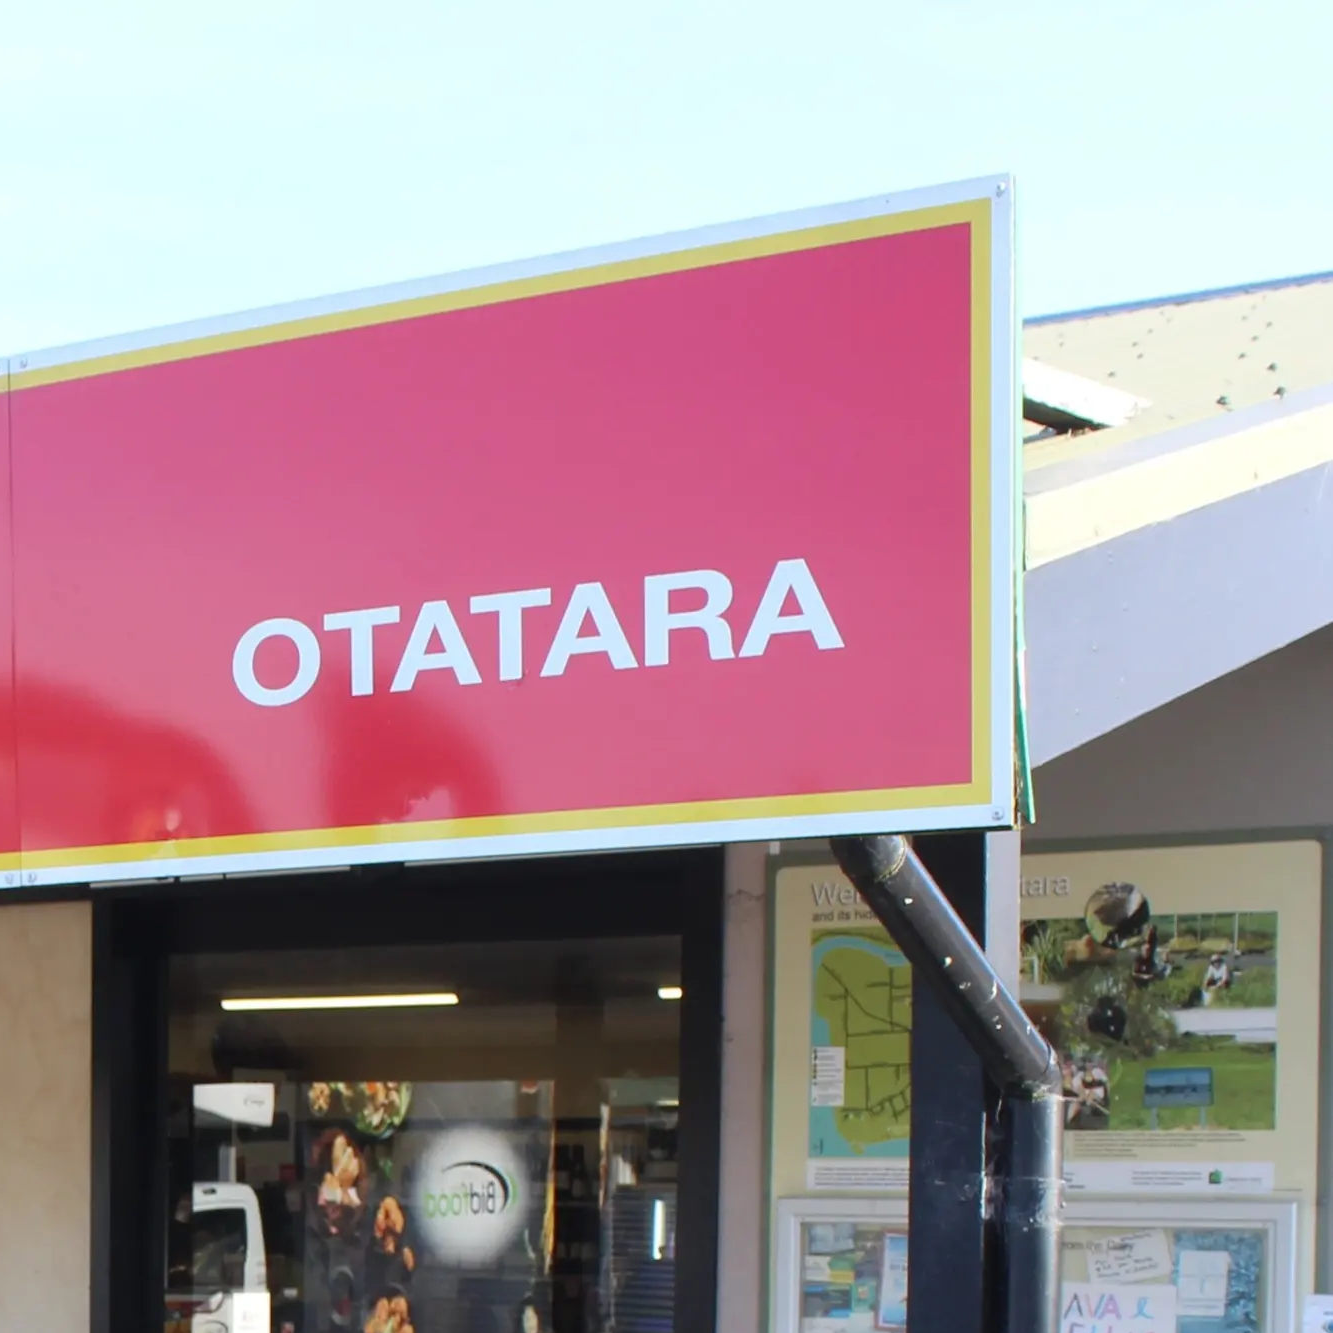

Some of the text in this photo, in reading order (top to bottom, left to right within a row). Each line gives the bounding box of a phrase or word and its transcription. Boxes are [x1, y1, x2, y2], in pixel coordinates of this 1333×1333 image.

[232, 558, 845, 707] OTATARA
[812, 912, 834, 922] and
[838, 911, 851, 920] its
[1064, 1293, 1121, 1320] AVA
